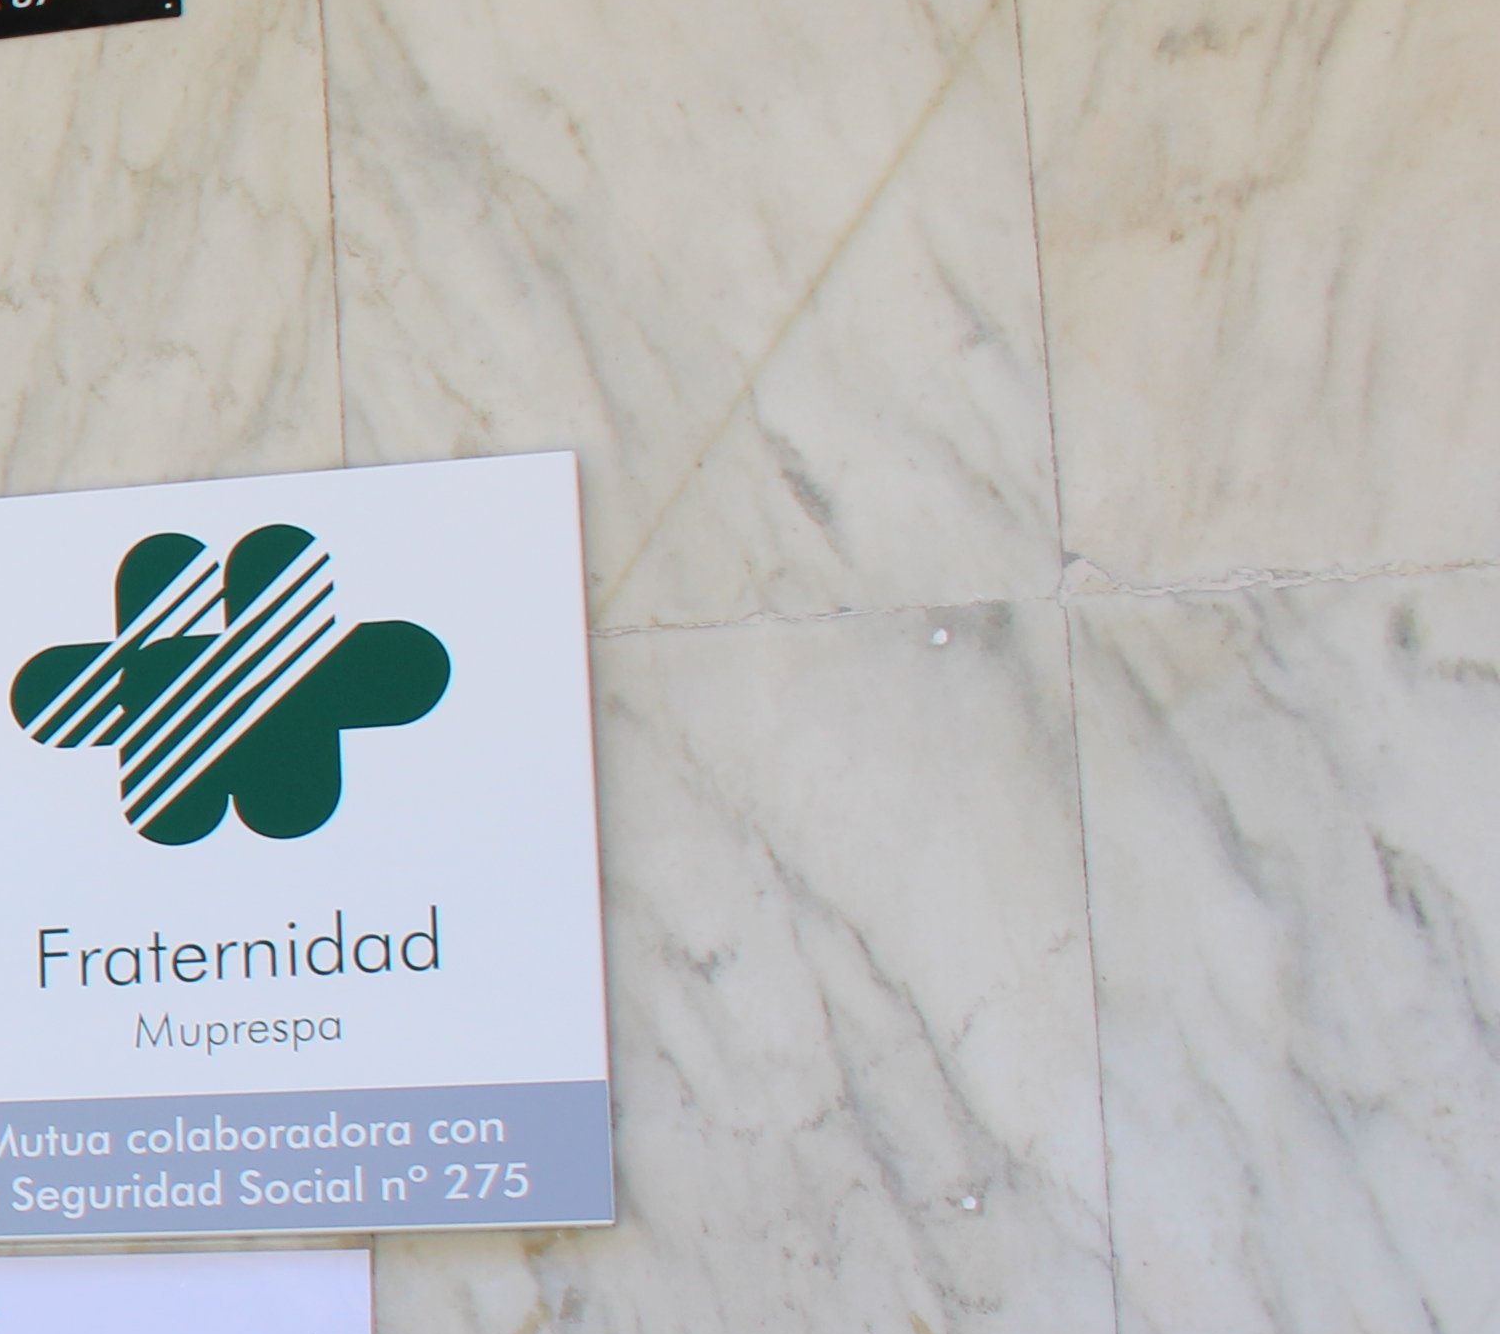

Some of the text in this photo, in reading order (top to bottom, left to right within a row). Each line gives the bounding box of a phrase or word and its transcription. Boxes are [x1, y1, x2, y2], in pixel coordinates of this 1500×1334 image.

[37, 905, 440, 989] Fraternidad
[135, 1012, 342, 1055] Muprespa
[126, 1112, 412, 1153] colaboradora
[427, 1116, 505, 1146] con
[12, 1169, 222, 1220] Seguridad
[239, 1166, 364, 1206] Social
[443, 1162, 530, 1200] 275
